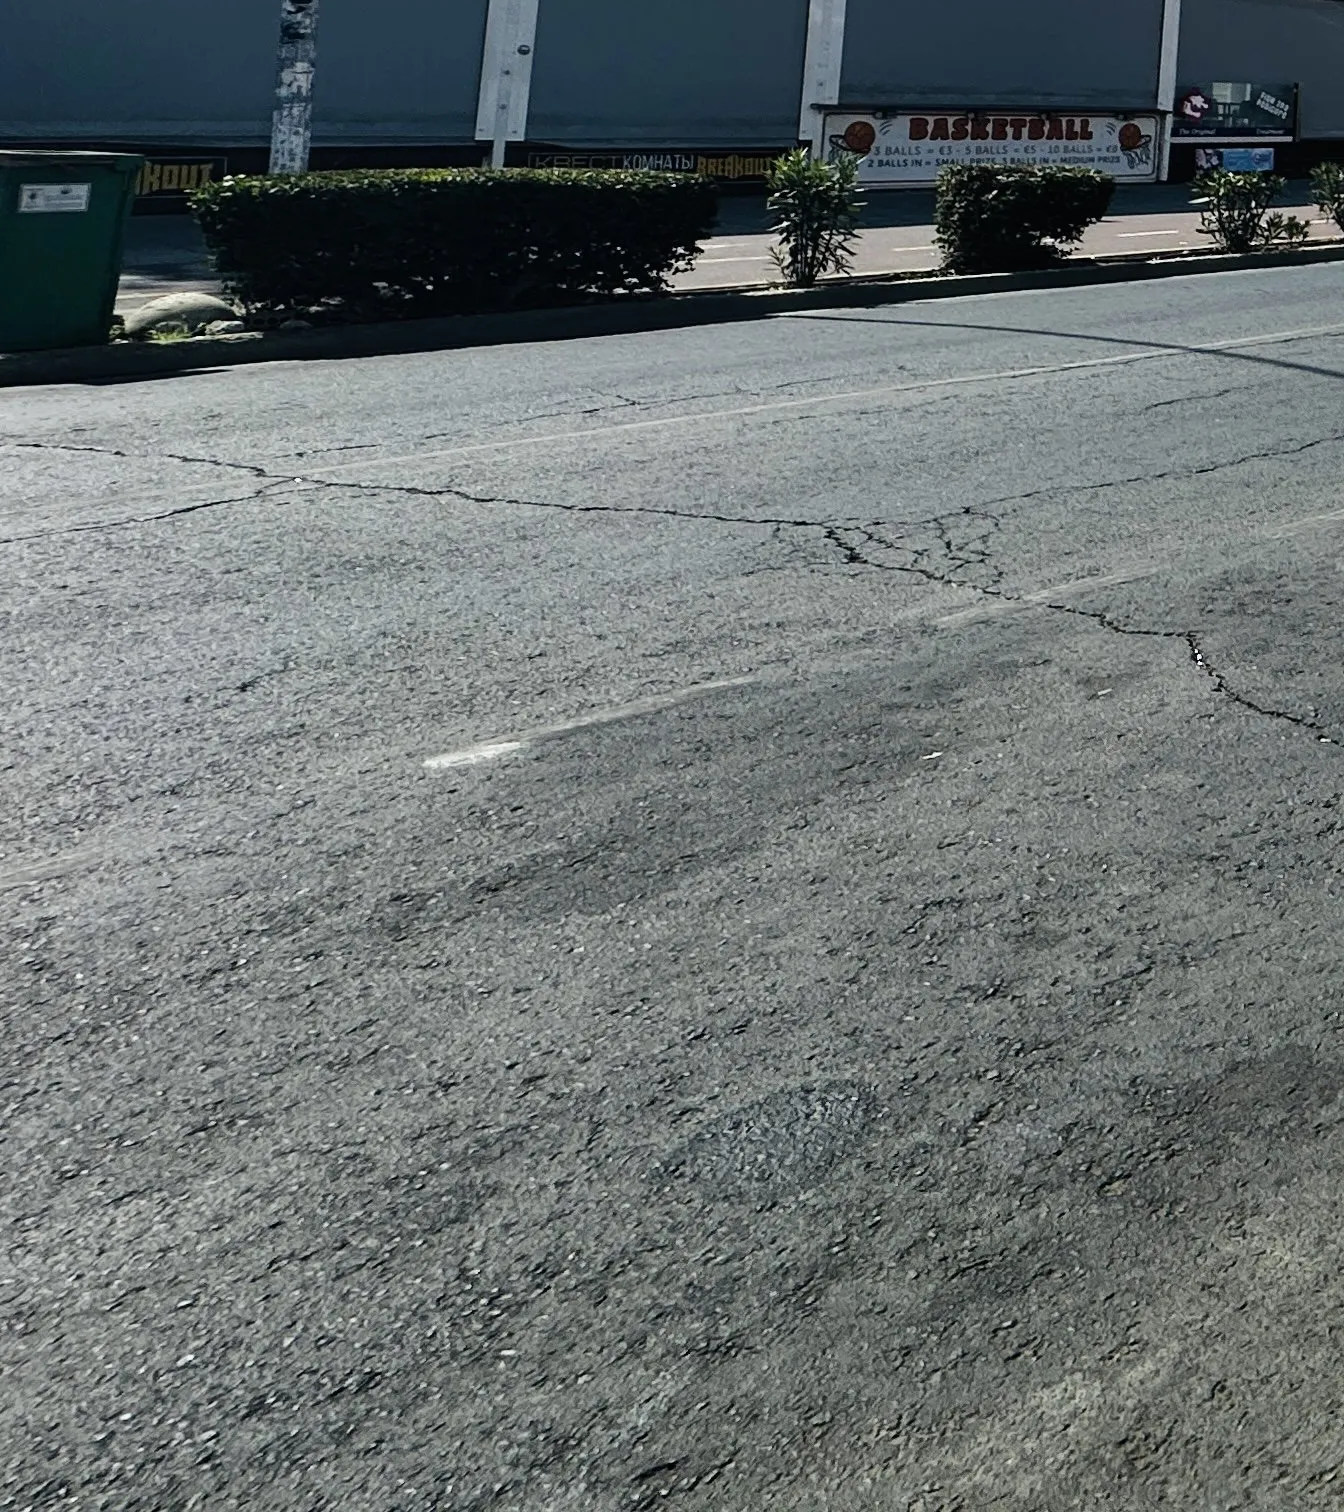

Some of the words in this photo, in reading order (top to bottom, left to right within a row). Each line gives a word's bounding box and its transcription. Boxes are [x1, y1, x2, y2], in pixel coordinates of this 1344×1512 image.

[908, 118, 1094, 141] BASKETBALL
[885, 146, 922, 156] BALLS
[975, 145, 1008, 155] BALLS
[1063, 144, 1093, 154] BALLS
[623, 154, 694, 172] КОМНАТЫ
[868, 159, 874, 168] 2
[877, 159, 908, 168] BALLS
[911, 158, 922, 167] IN
